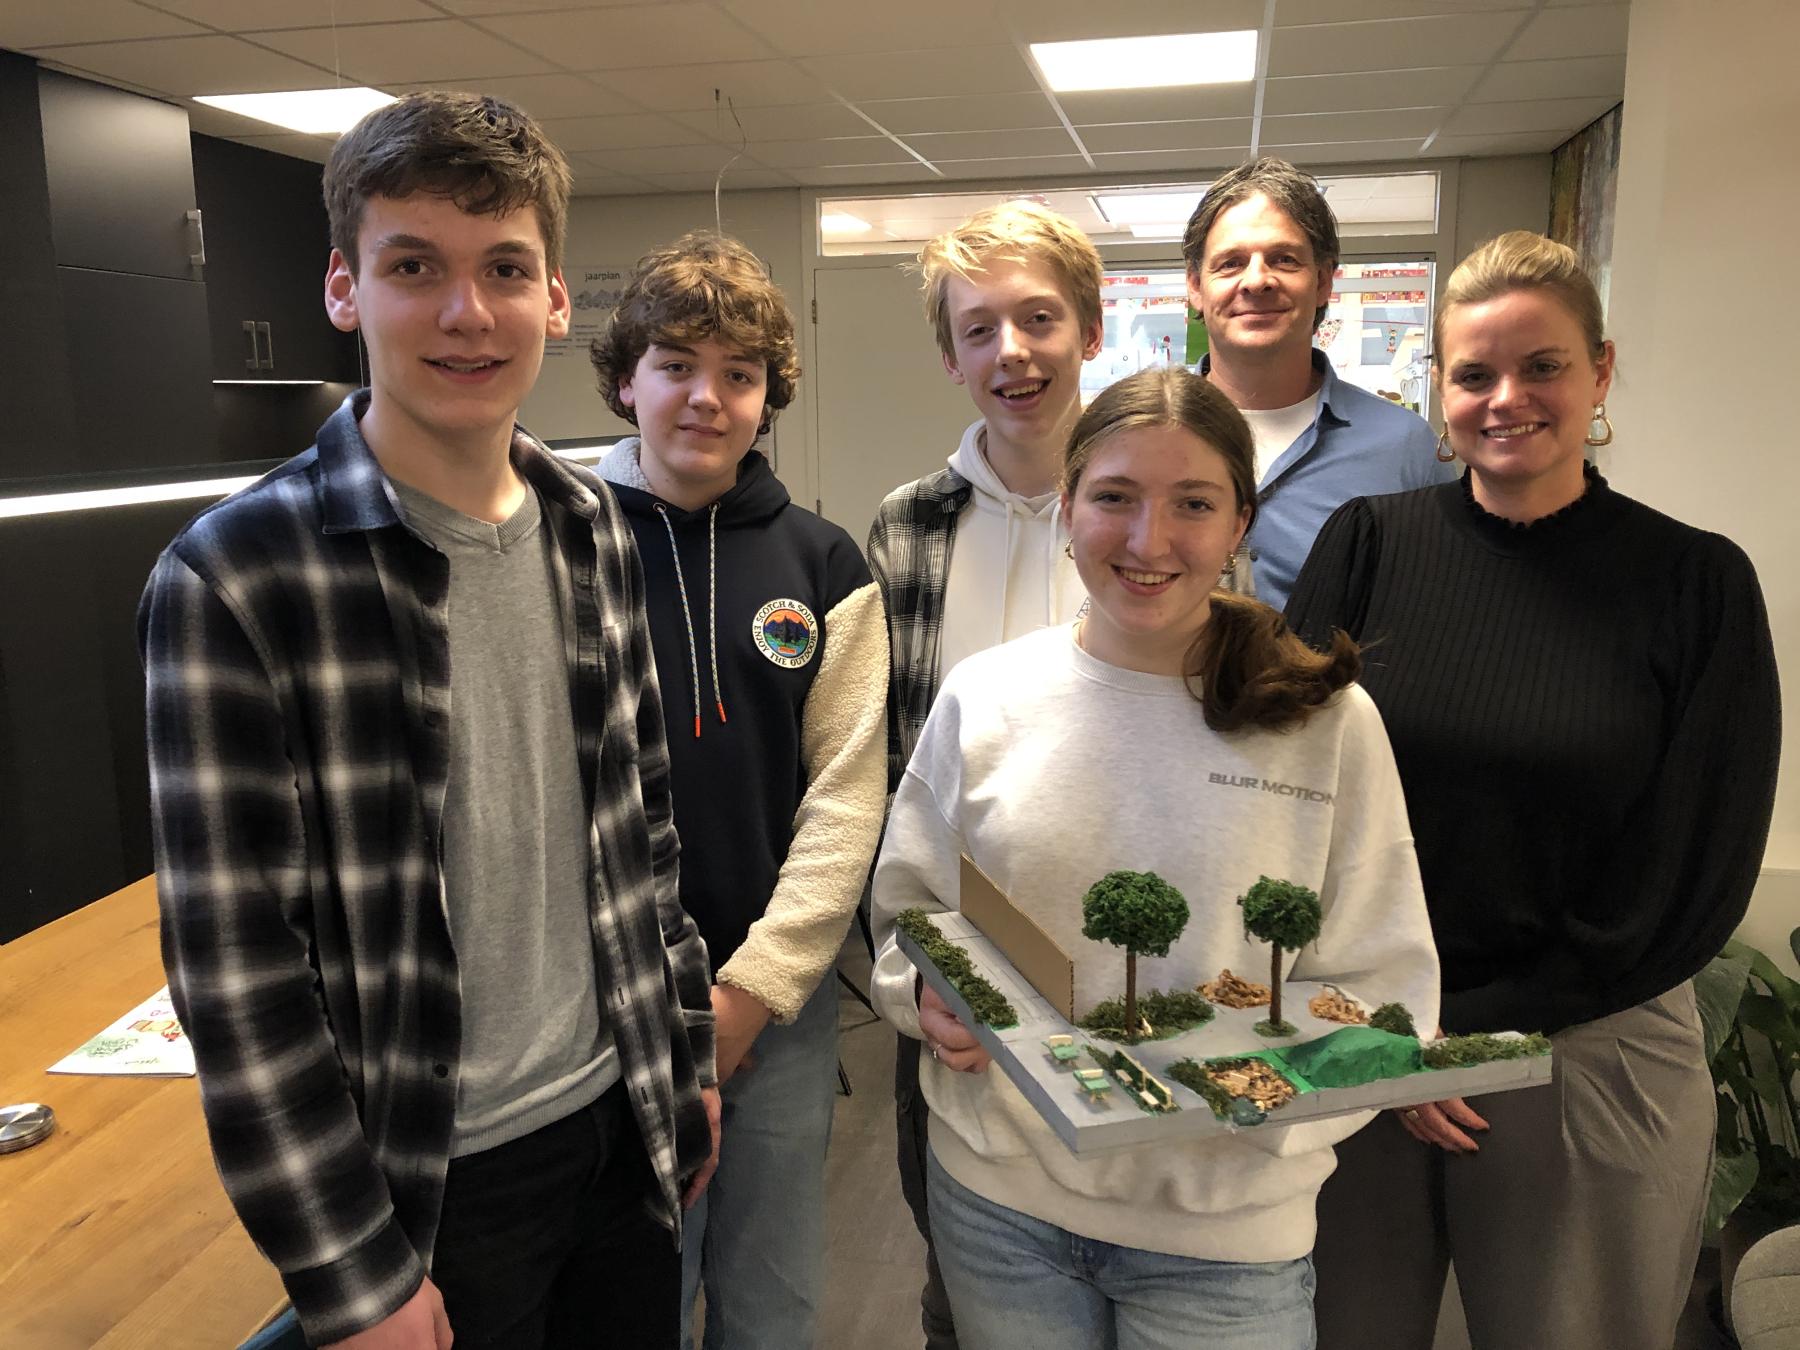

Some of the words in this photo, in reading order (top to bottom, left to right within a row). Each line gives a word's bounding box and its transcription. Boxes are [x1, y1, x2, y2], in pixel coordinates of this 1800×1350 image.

[584, 272, 620, 282] jaarplan
[756, 601, 786, 623] SCOTCH
[788, 601, 796, 609] &
[797, 604, 815, 627] SODA
[754, 625, 769, 652] ENJOY
[770, 651, 787, 665] THE
[790, 629, 816, 667] OUTDOORS
[1208, 772, 1258, 789] BLUR
